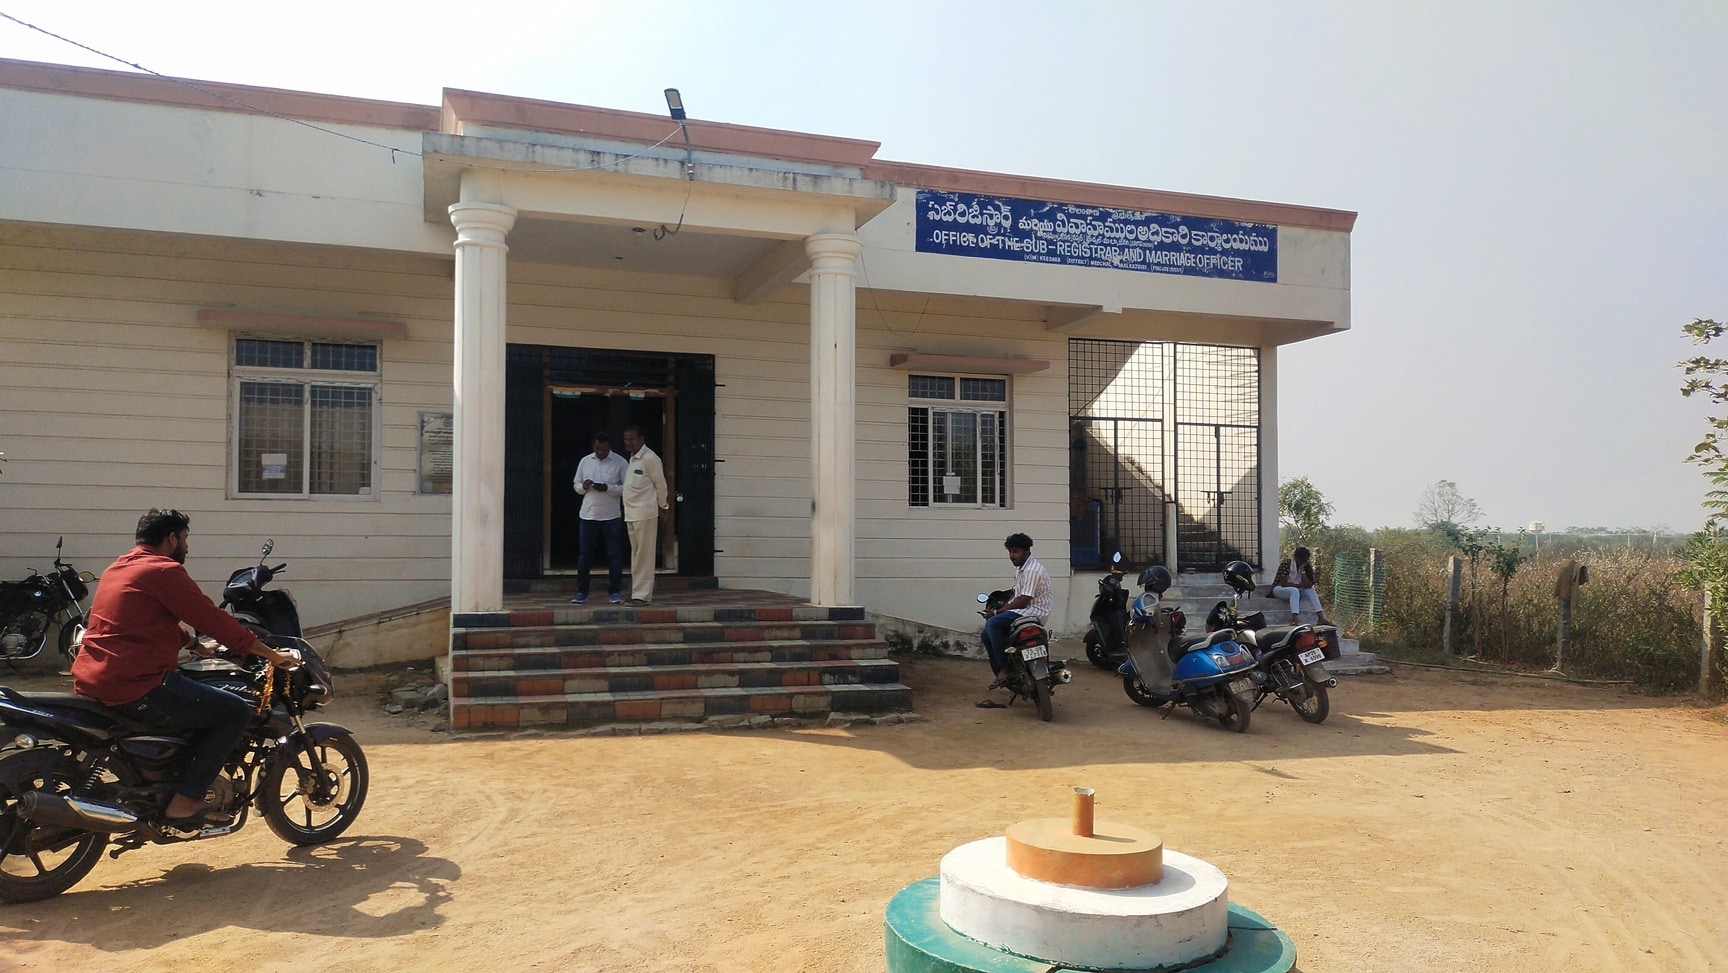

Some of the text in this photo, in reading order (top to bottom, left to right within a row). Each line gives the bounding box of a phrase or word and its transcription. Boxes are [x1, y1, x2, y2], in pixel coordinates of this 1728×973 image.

[933, 229, 976, 247] OFFICE
[978, 234, 994, 248] OF
[996, 236, 1020, 251] THE
[1023, 237, 1047, 253] SUB
[1057, 240, 1120, 260] REGISTRAR
[1123, 248, 1143, 263] AND
[1146, 250, 1196, 267] MARRIAGE
[1196, 253, 1244, 271] OFFICER
[1138, 223, 1190, 245] అధికారి
